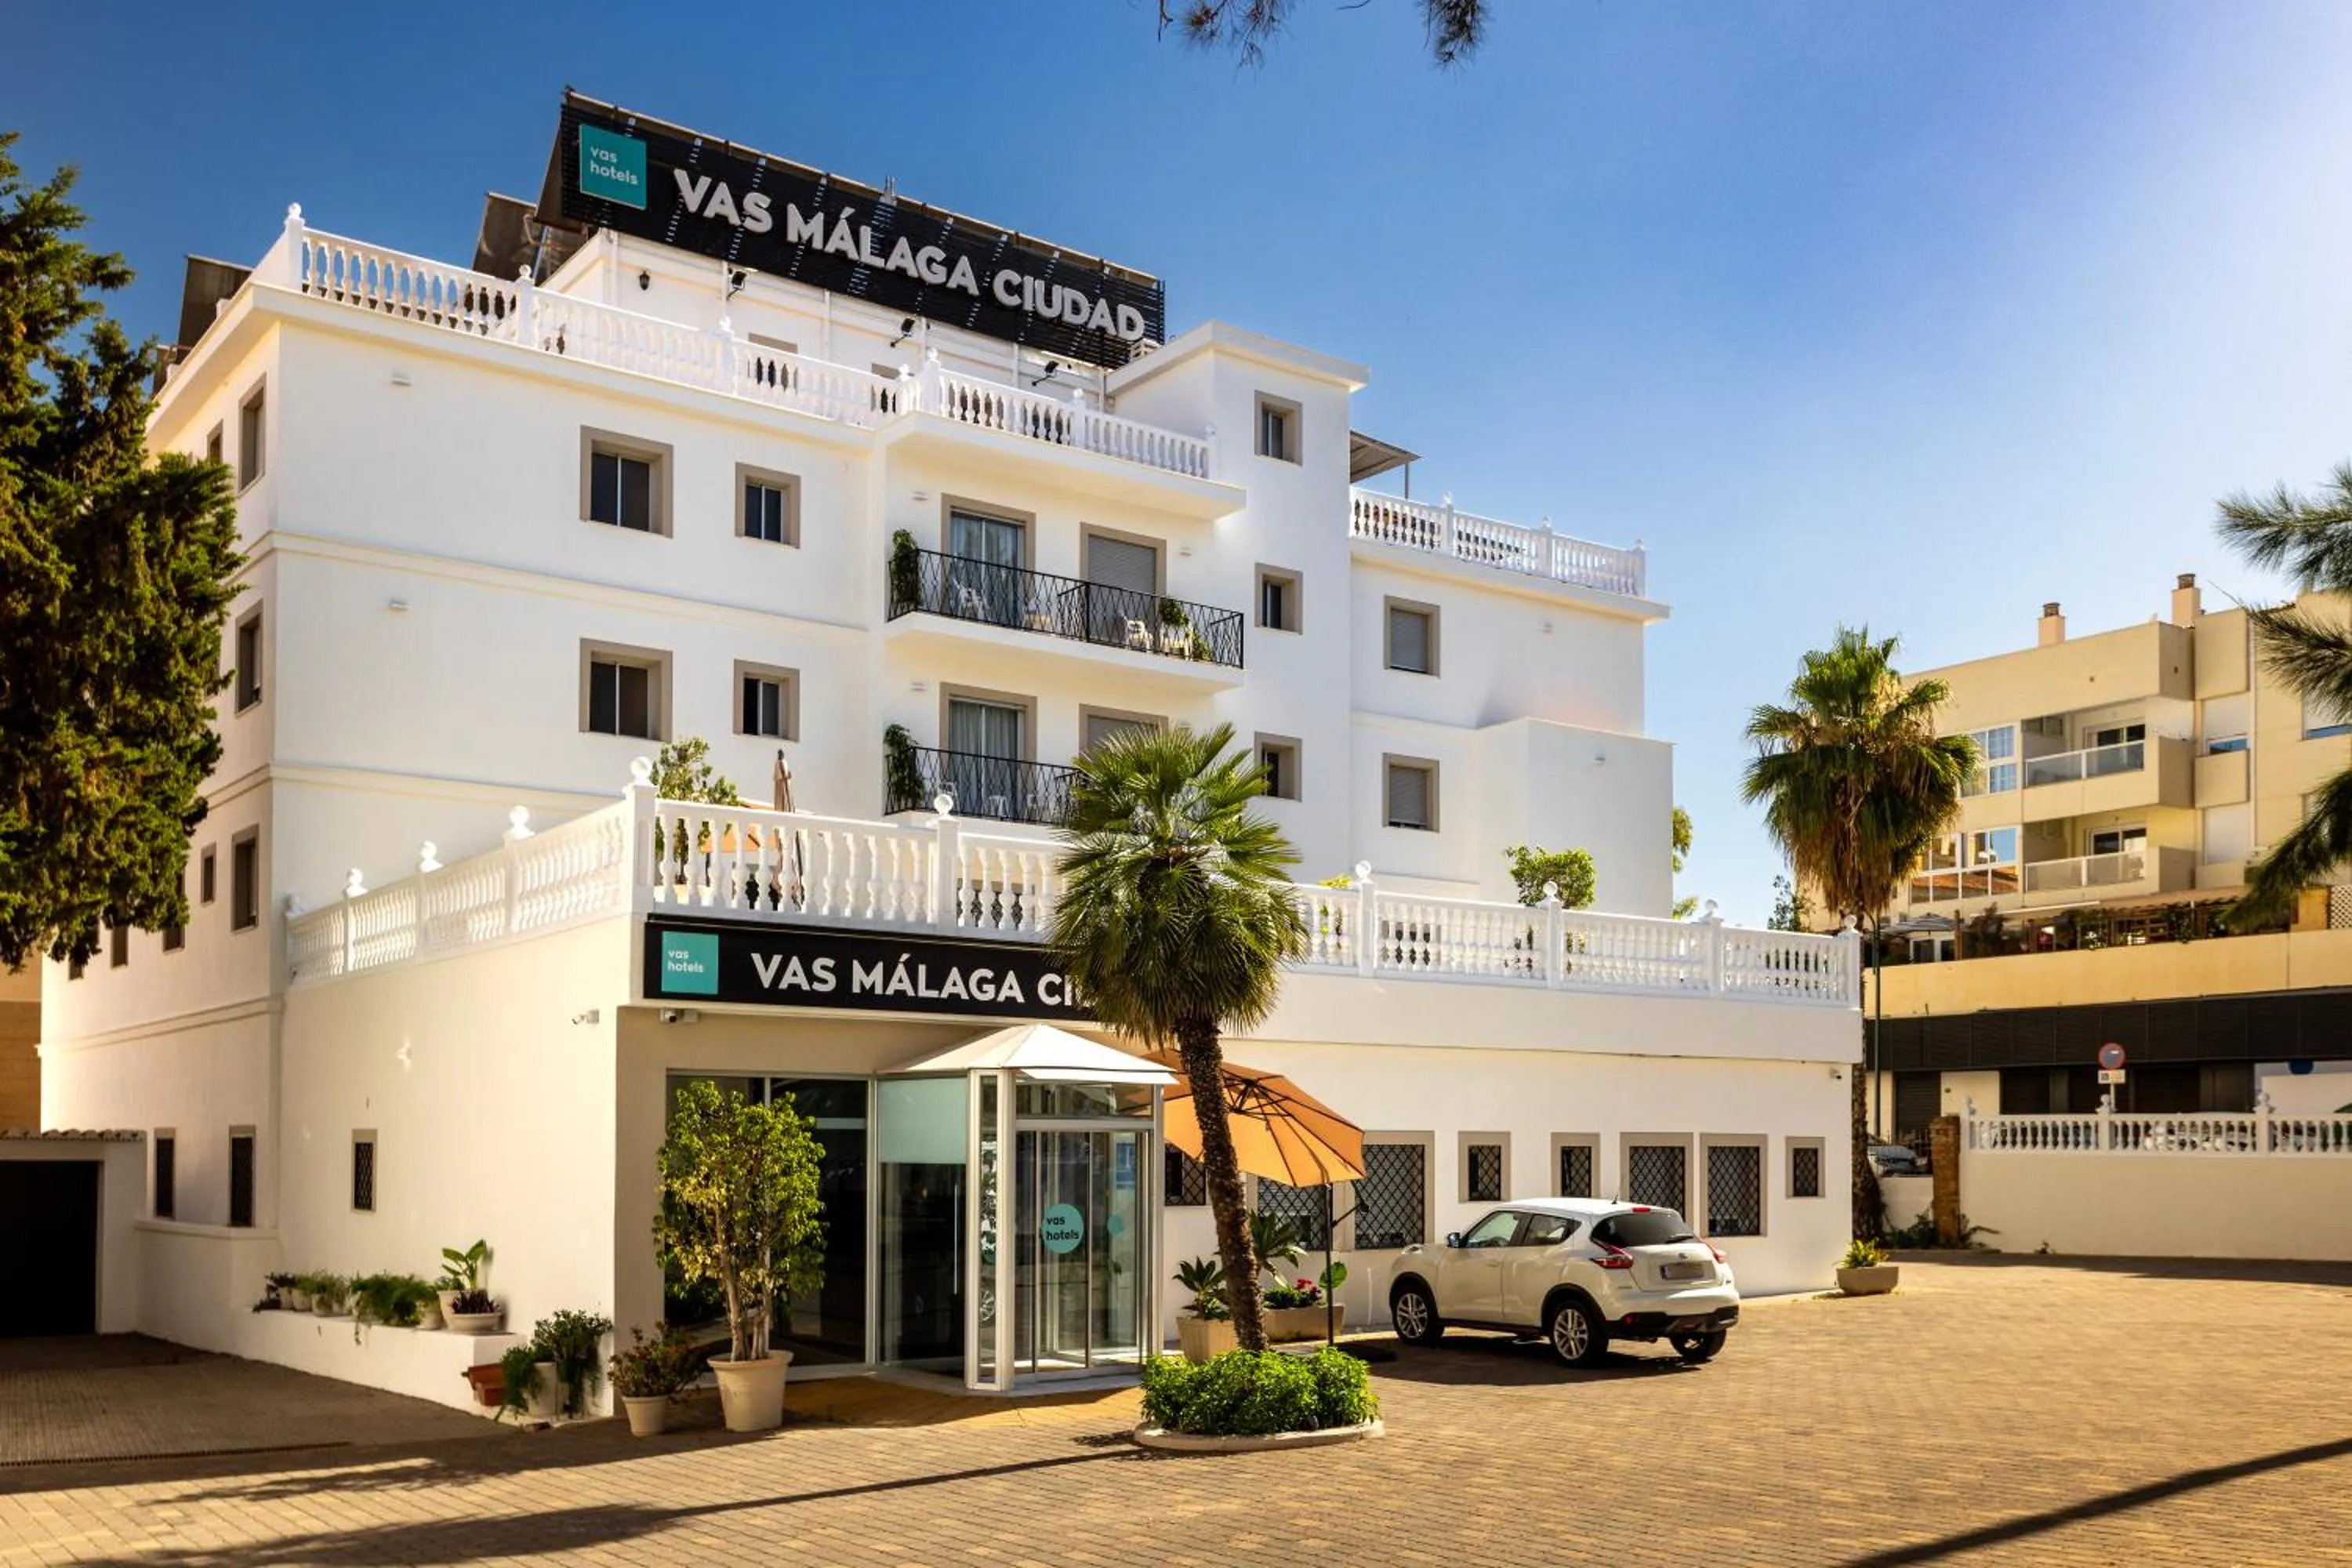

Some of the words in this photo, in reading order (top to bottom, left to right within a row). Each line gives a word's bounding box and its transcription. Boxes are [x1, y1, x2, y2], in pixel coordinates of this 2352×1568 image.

[590, 147, 617, 163] vas
[590, 160, 638, 185] hotels
[673, 168, 773, 233] VAS
[787, 203, 979, 296] MÁLAGA
[993, 269, 1145, 341] CIUDAD
[668, 949, 689, 959] vas
[668, 960, 704, 973] hotels
[750, 953, 837, 992] VAS
[852, 953, 1025, 1003] MÁLAGA
[1046, 1229, 1080, 1240] hotels
